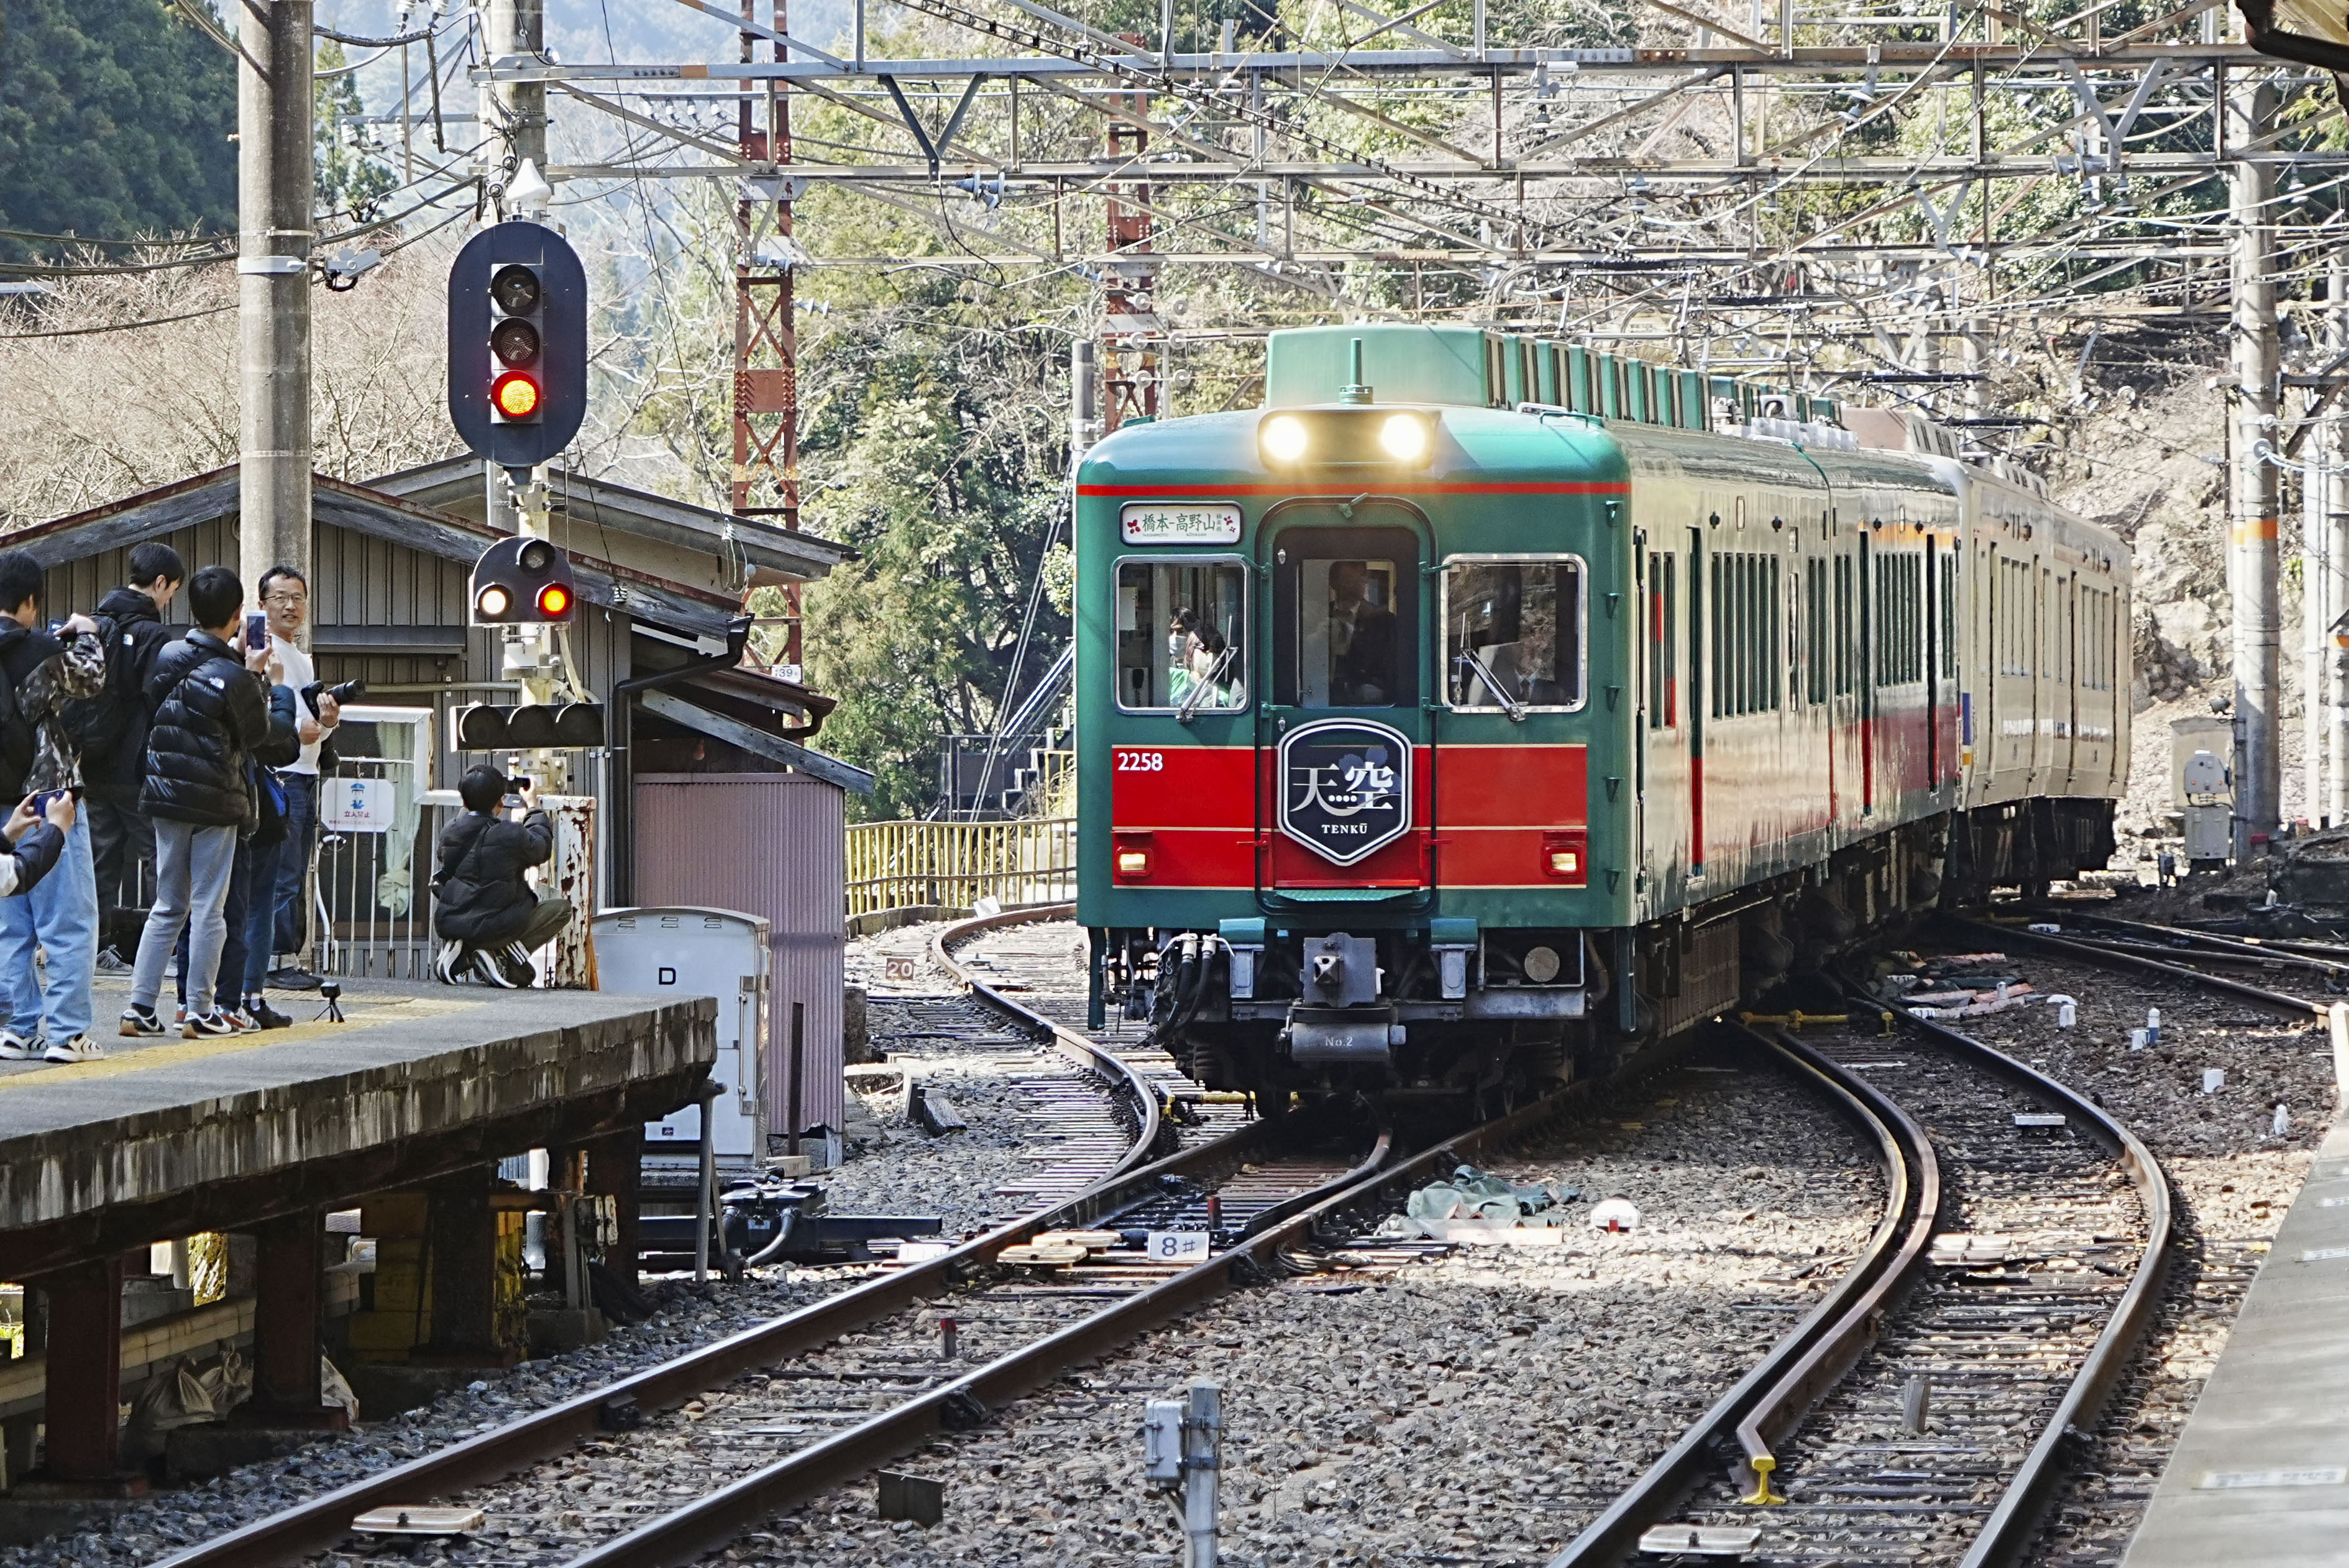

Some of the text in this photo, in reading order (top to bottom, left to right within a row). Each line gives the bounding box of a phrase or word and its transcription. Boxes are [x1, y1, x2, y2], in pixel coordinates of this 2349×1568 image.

[1118, 752, 1163, 771] 2258
[1289, 761, 1396, 817] 天空
[1321, 823, 1368, 834] TENKŪ
[658, 967, 677, 985] D
[887, 961, 913, 978] 20
[1325, 1036, 1353, 1047] No.2
